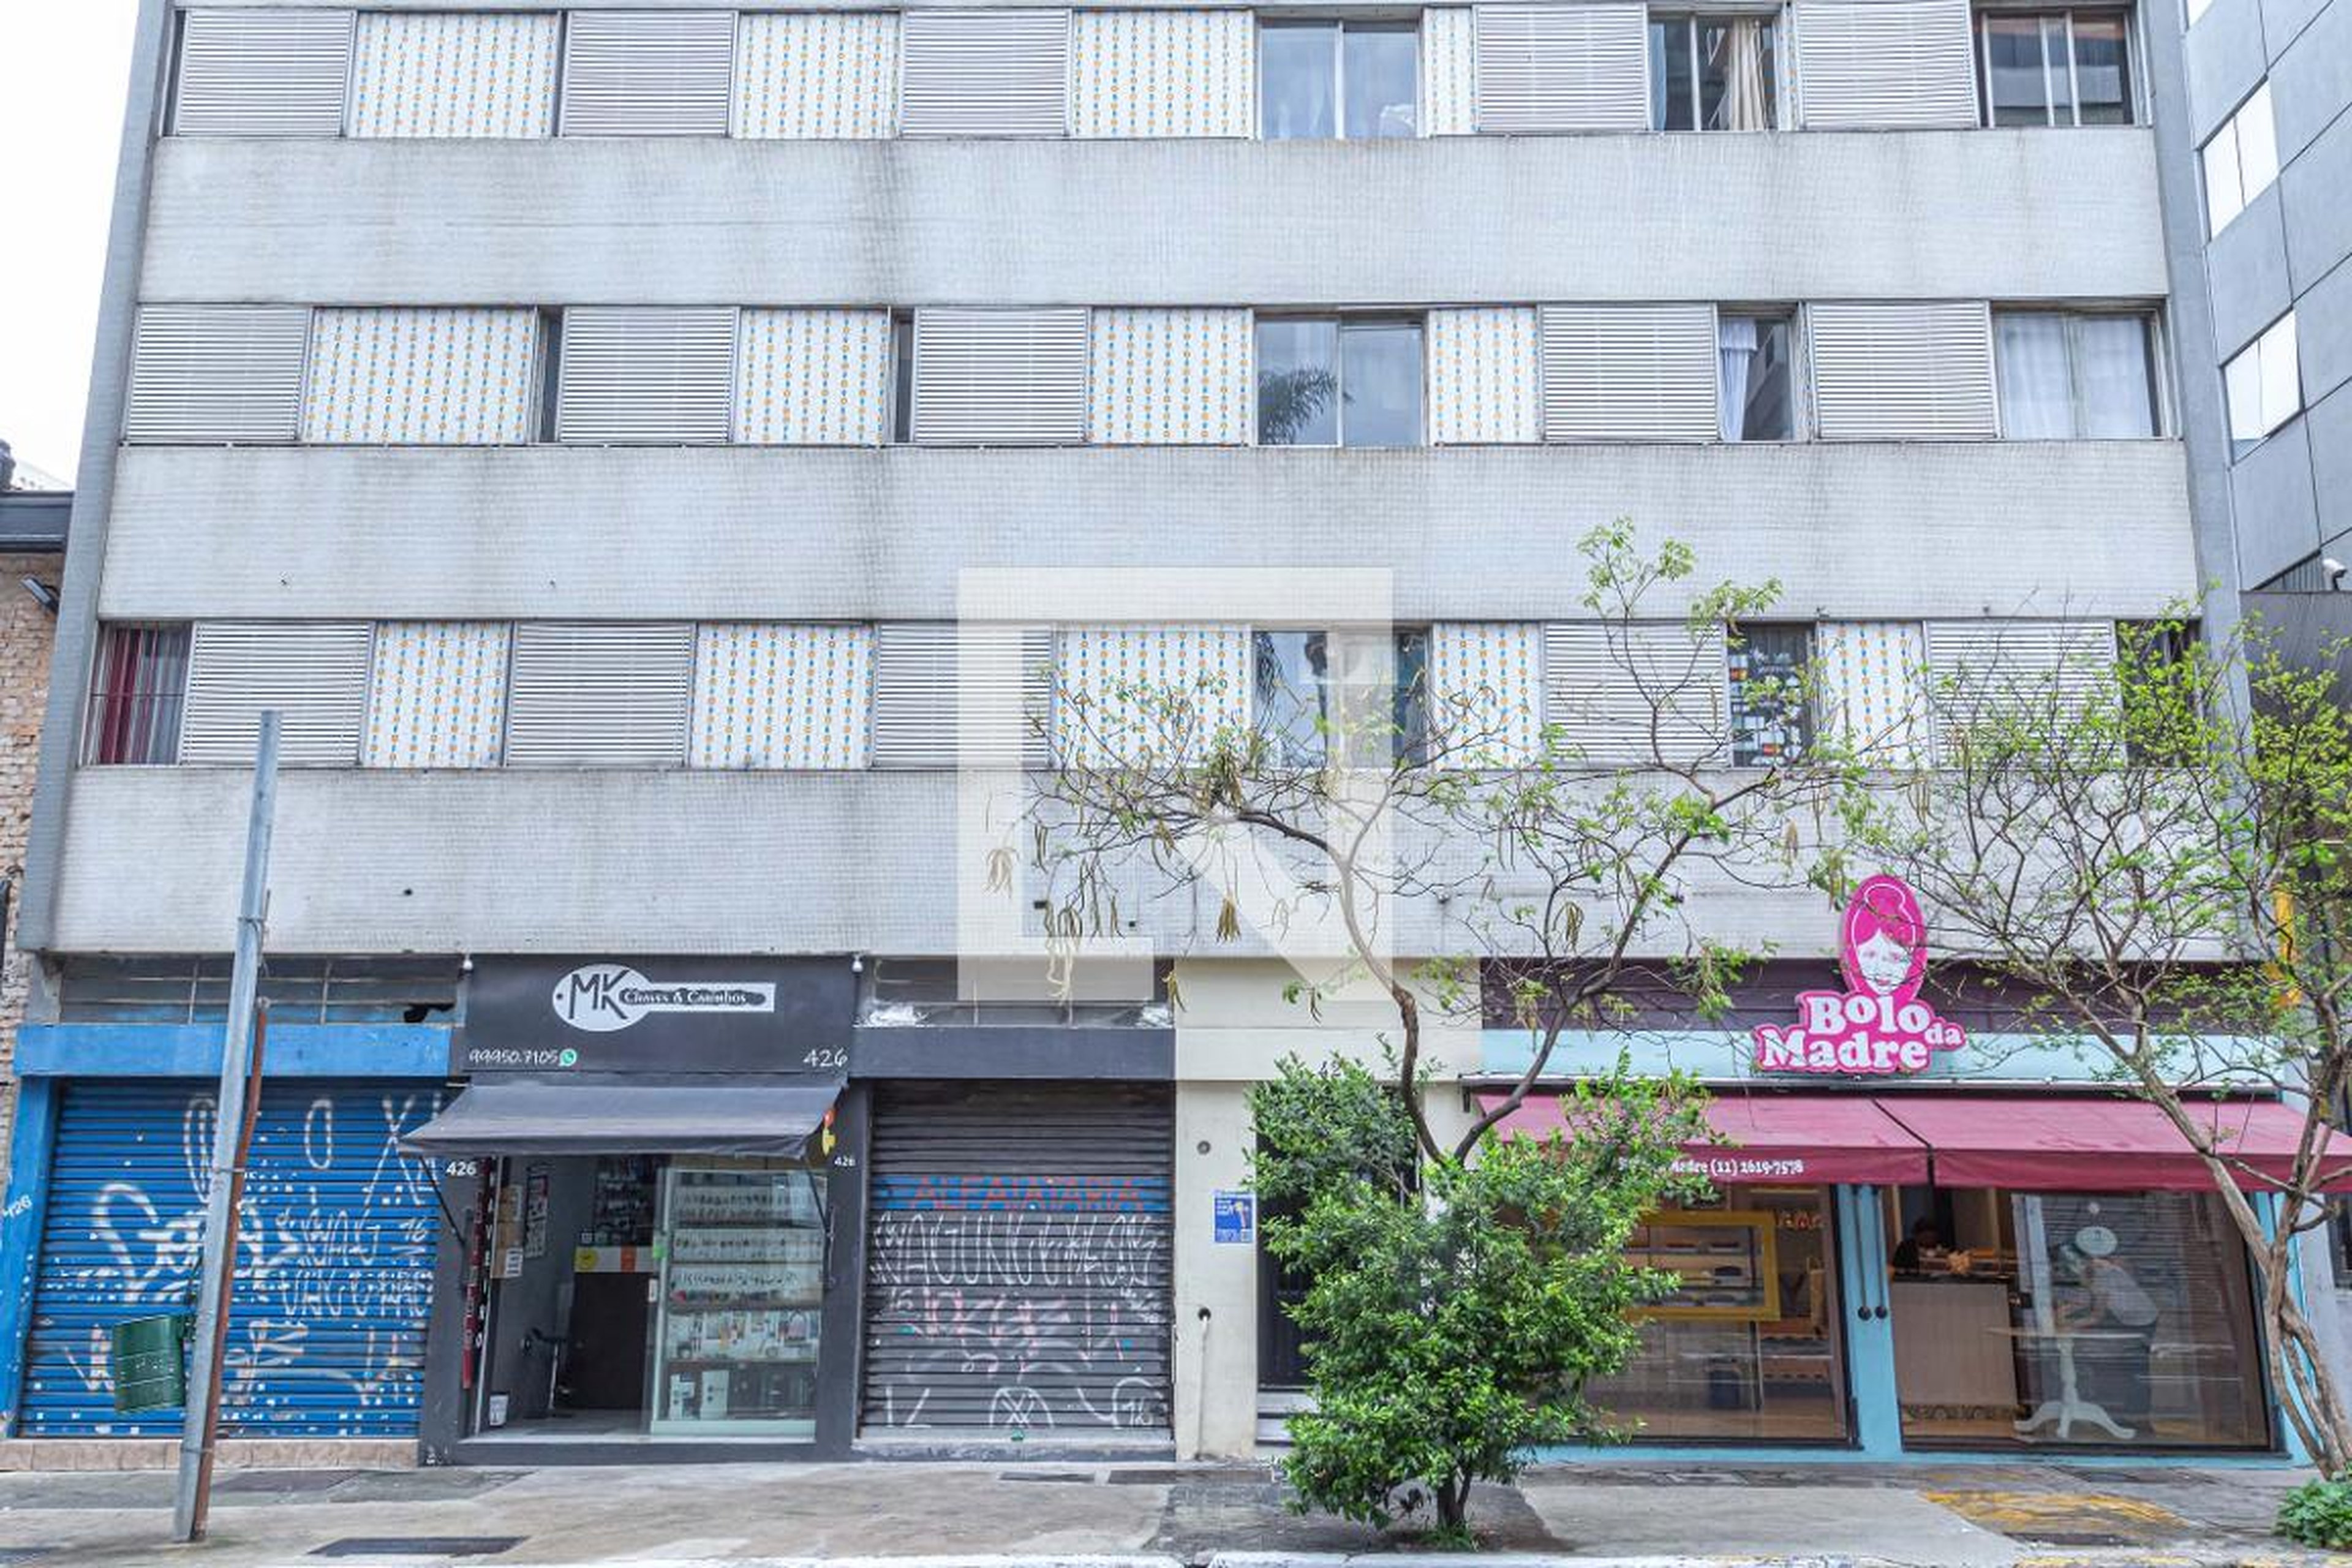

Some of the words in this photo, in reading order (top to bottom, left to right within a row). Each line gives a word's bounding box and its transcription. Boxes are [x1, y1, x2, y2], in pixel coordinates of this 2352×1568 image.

[568, 969, 630, 1019] MK
[1807, 995, 1931, 1035] Bolo
[1924, 1023, 1962, 1046] da
[802, 1047, 848, 1067] 426
[1760, 1028, 1928, 1068] Madre
[445, 1161, 477, 1176] 426
[1710, 1158, 1739, 1177] (11)
